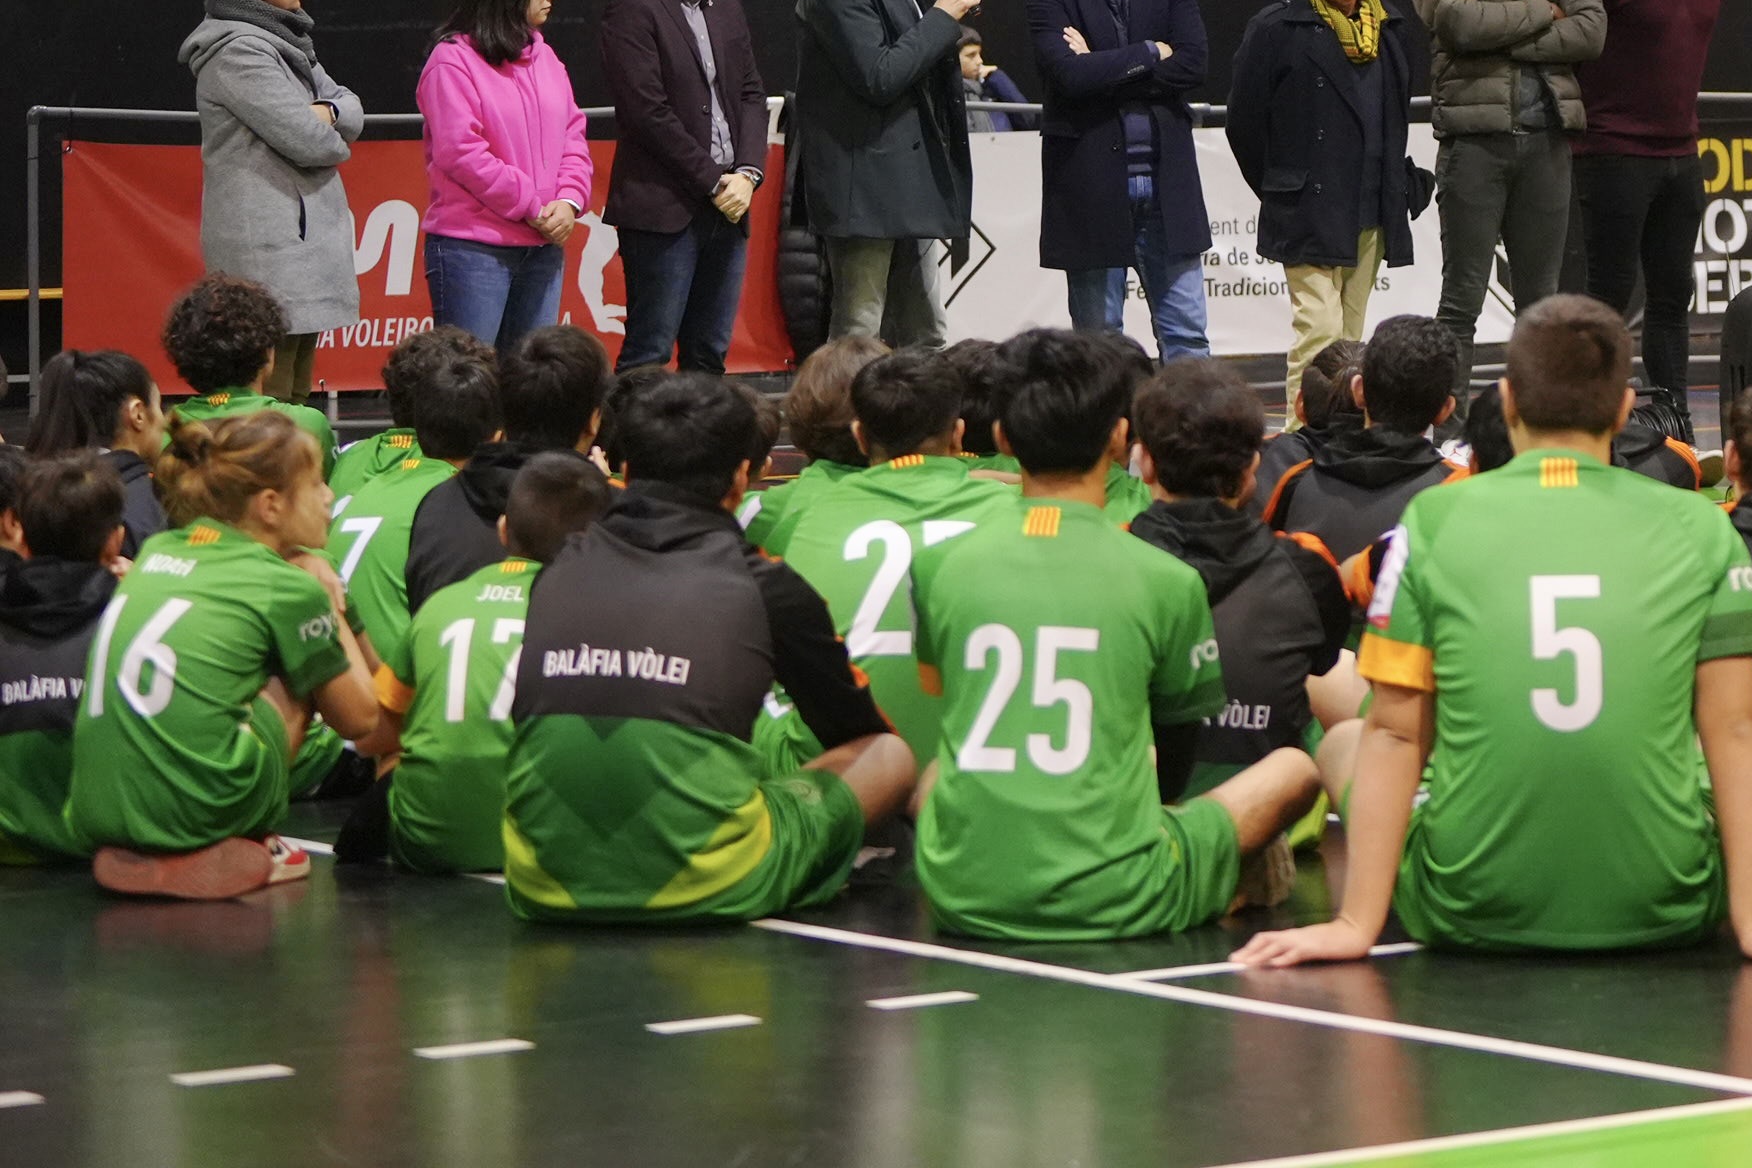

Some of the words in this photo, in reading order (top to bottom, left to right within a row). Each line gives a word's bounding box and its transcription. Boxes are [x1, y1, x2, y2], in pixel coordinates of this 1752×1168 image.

[1227, 248, 1249, 266] de
[1204, 277, 1289, 298] Tradicion
[475, 584, 525, 603] JOEL
[88, 594, 195, 719] 16
[438, 617, 526, 723] 17
[542, 642, 623, 679] BALÀFIA
[626, 645, 691, 686] VÒLEI
[1528, 574, 1604, 733] 5
[1, 673, 67, 706] BALÀFIA
[956, 622, 1100, 776] 25
[1217, 698, 1271, 730] VÒLEI
